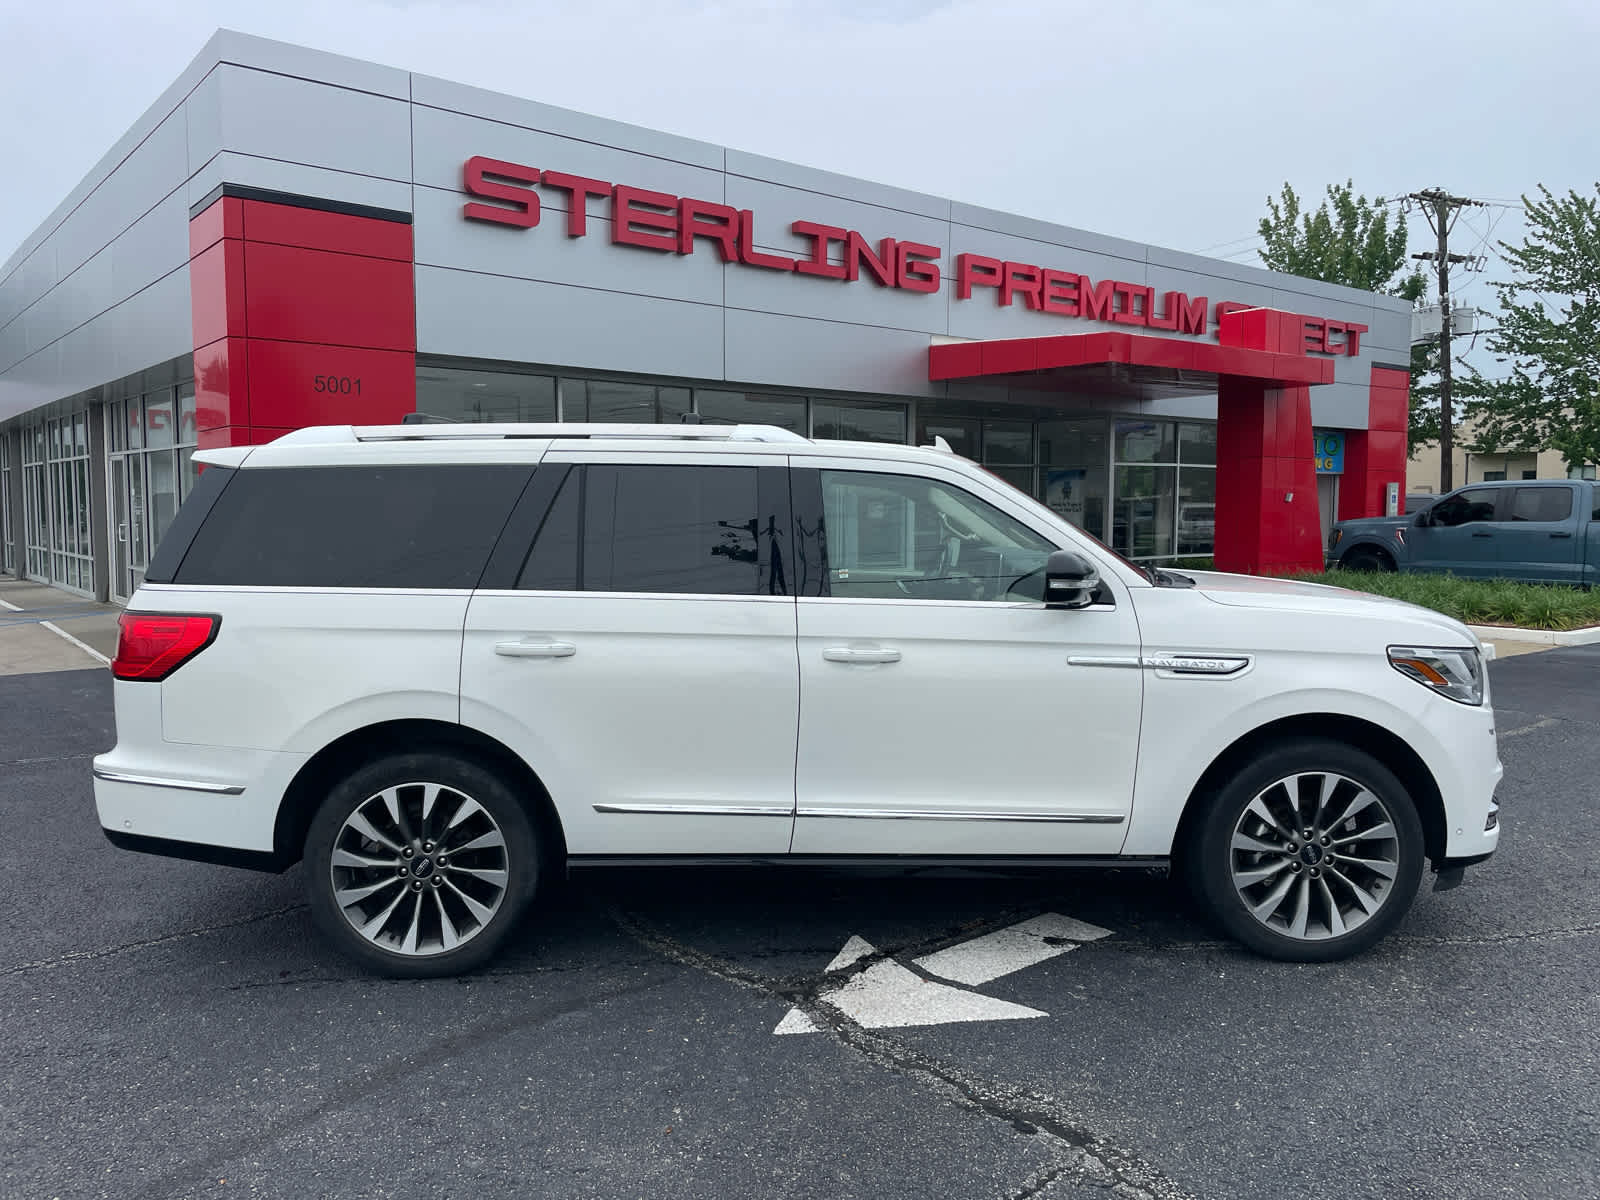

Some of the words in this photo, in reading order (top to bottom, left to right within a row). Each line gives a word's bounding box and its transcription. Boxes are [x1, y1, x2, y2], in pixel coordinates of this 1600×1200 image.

[463, 155, 941, 294] STERLING
[957, 253, 1208, 335] PREMIUM
[1215, 301, 1368, 356] ECT
[313, 375, 361, 397] 5001
[1144, 658, 1226, 670] NAVIGATOR
